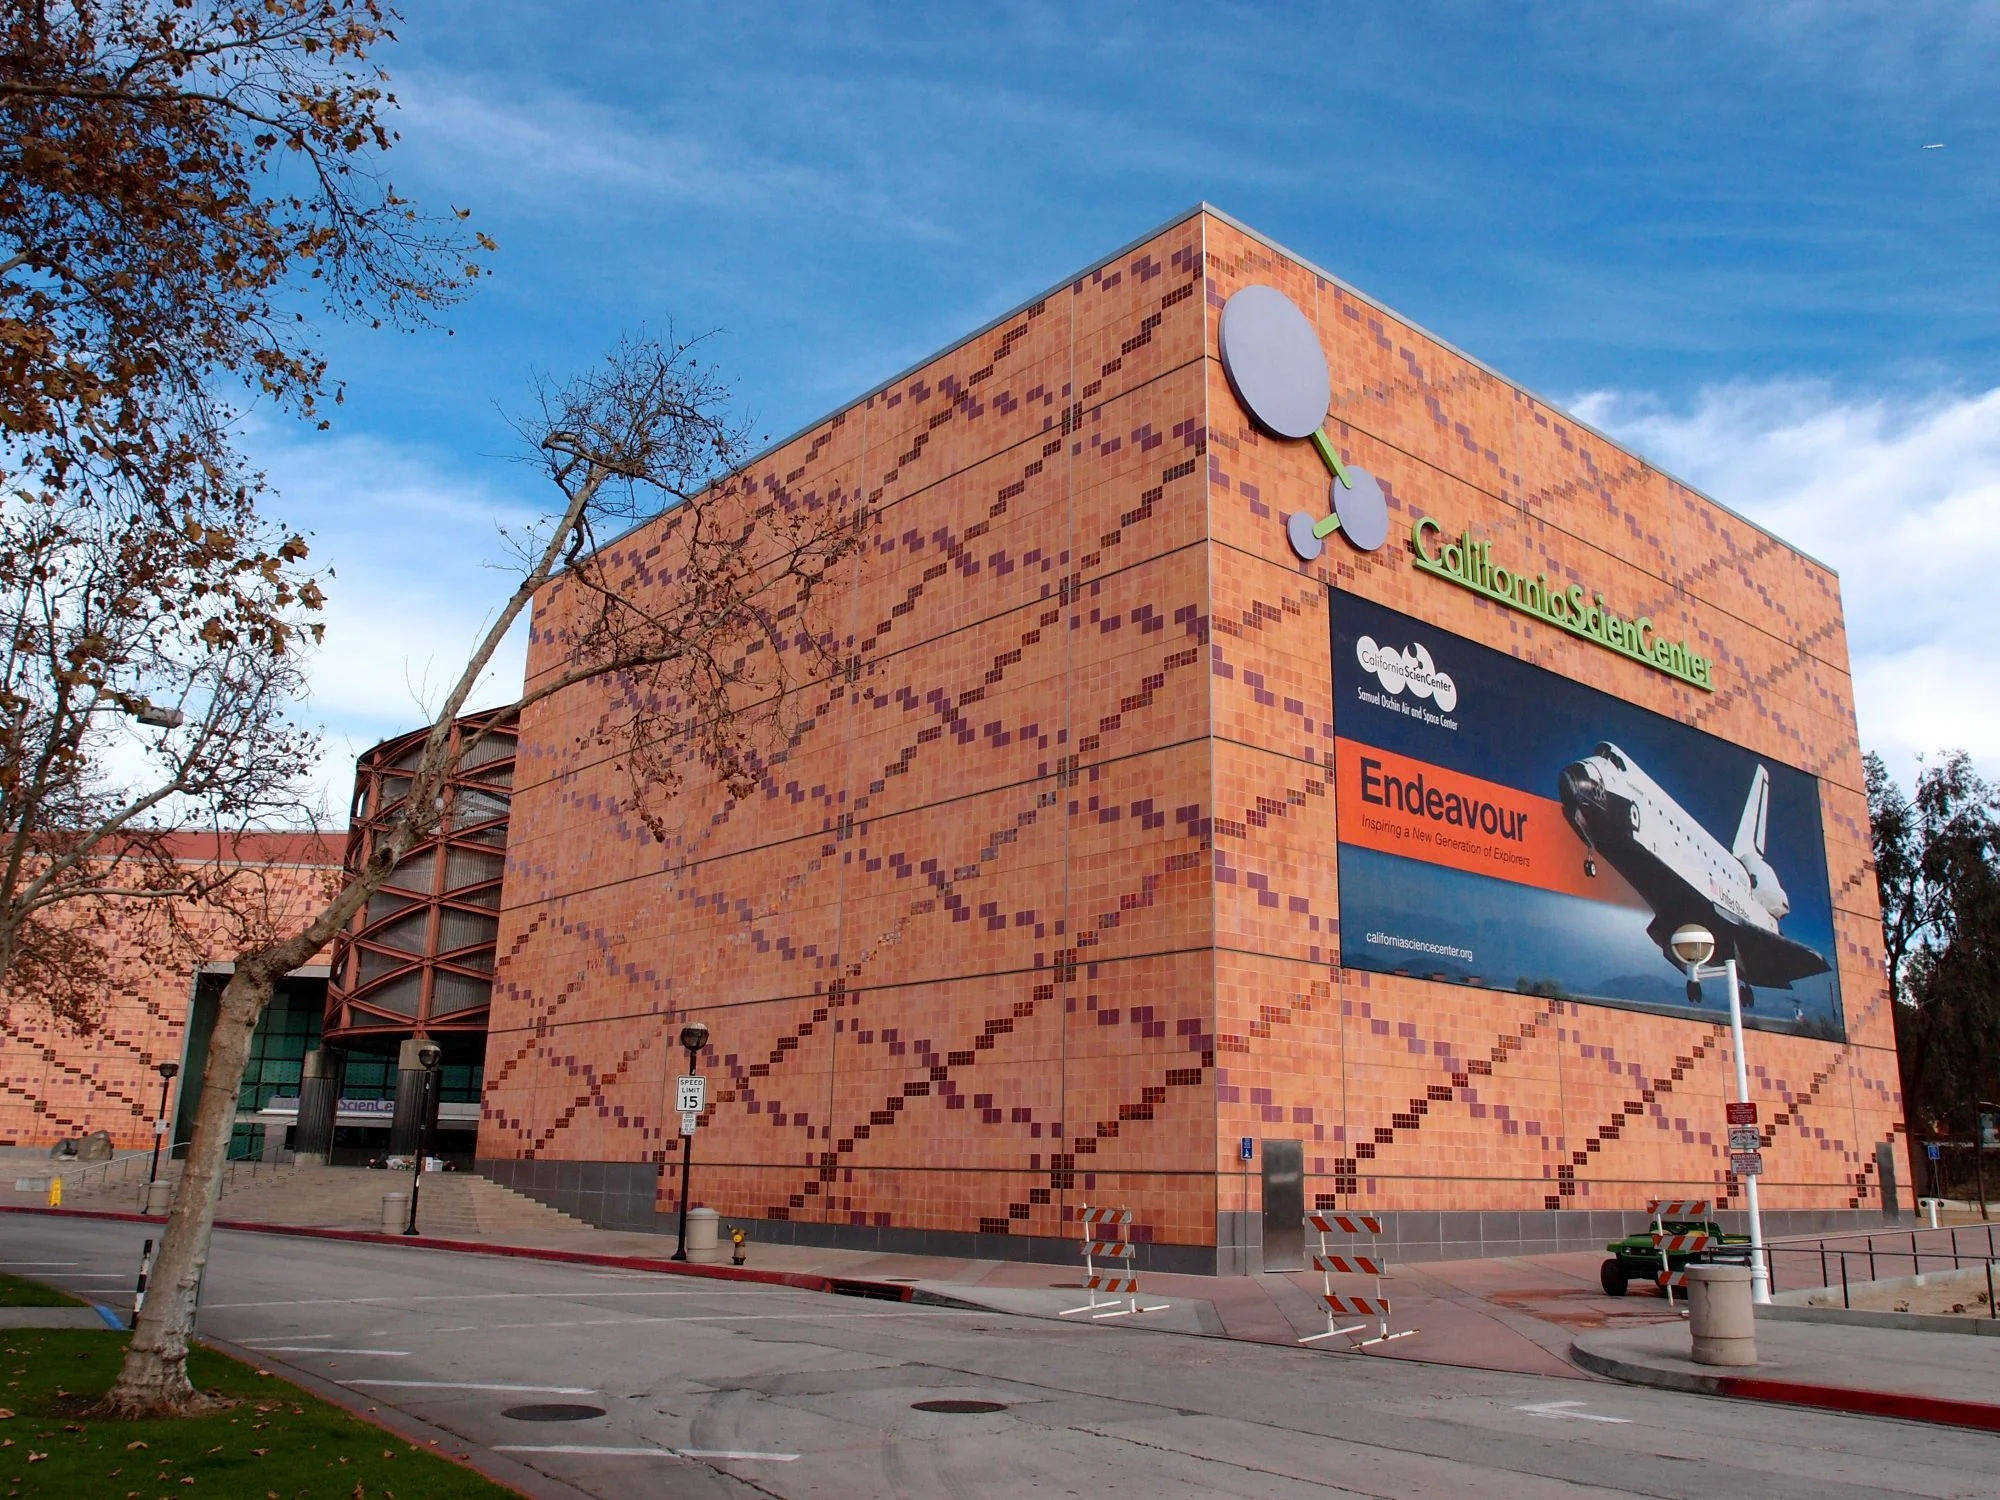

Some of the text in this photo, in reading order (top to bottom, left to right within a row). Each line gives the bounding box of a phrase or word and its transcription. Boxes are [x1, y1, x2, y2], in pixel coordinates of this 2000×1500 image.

[1412, 516, 1713, 686] CaliforniaScienCenter
[1358, 687, 1458, 731] Samuel Oschin Air and Space Center
[1360, 756, 1527, 842] Endeavour
[1362, 814, 1531, 868] Inspiring a New Generation of Explorers
[1366, 931, 1473, 962] californiasciencecenter.org
[683, 1095, 698, 1109] 15
